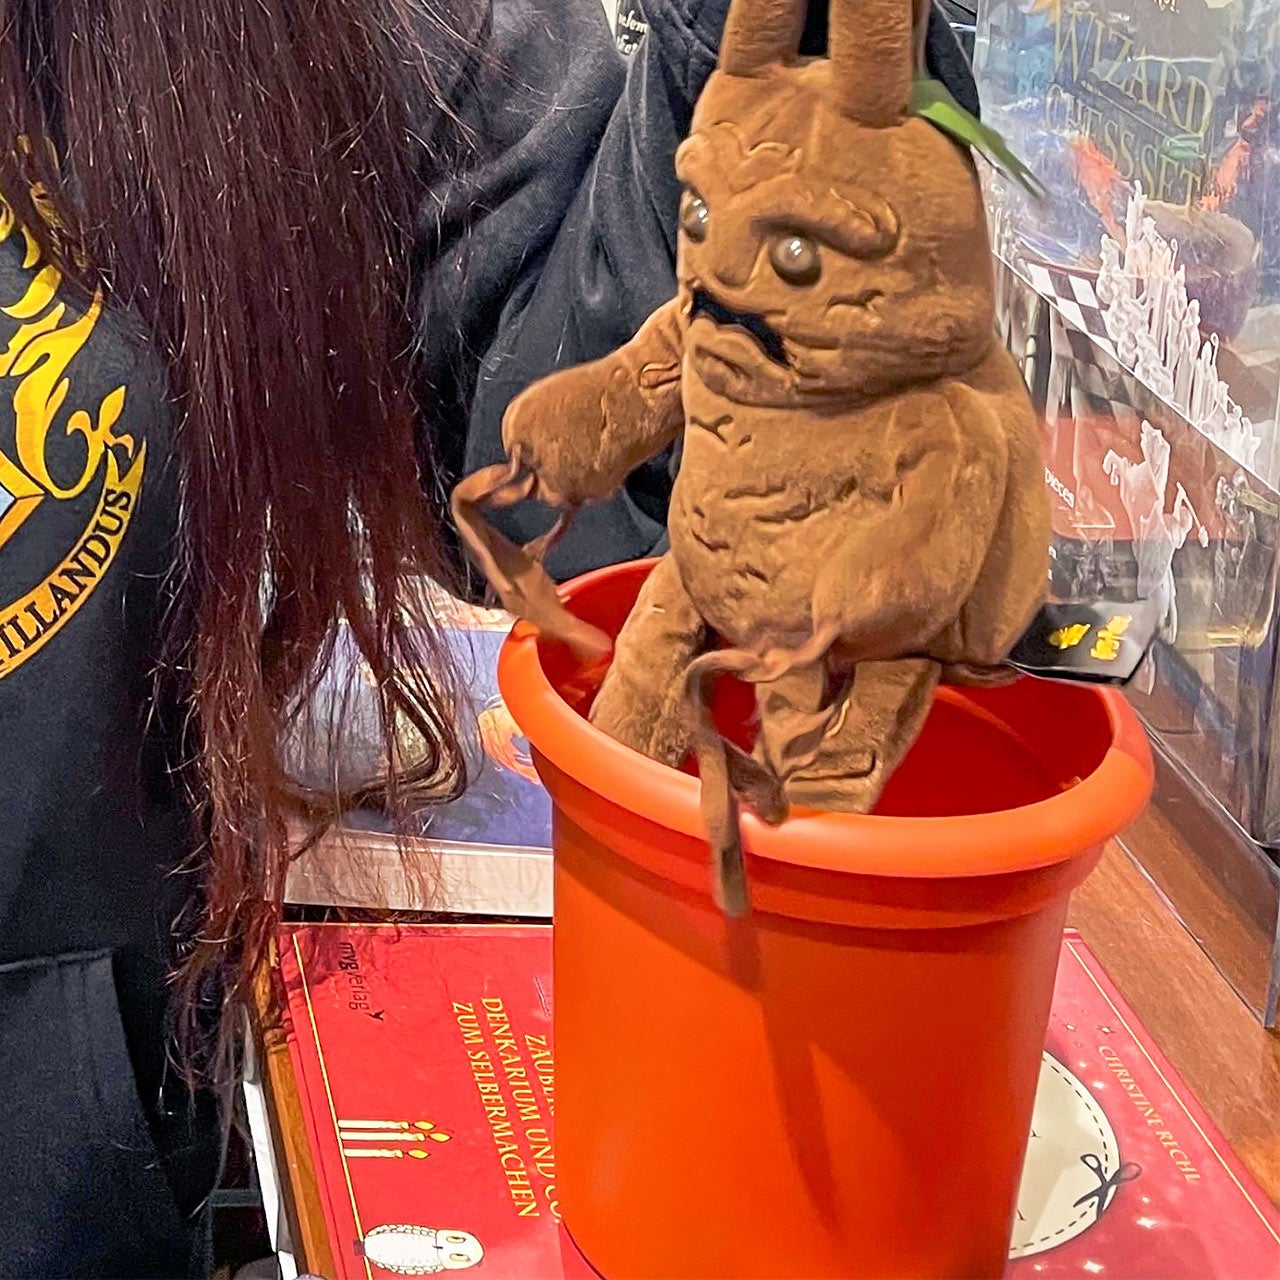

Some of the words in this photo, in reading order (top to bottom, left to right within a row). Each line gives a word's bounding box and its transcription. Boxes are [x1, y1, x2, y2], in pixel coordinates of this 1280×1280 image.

[1051, 3, 1214, 138] WIZARD
[452, 1002, 485, 1045] ZUM
[481, 998, 541, 1121] DENKARIUM
[525, 1128, 556, 1179] UND
[1098, 1045, 1165, 1127] CHRISTINE
[467, 1051, 541, 1218] SELBERMACHEN
